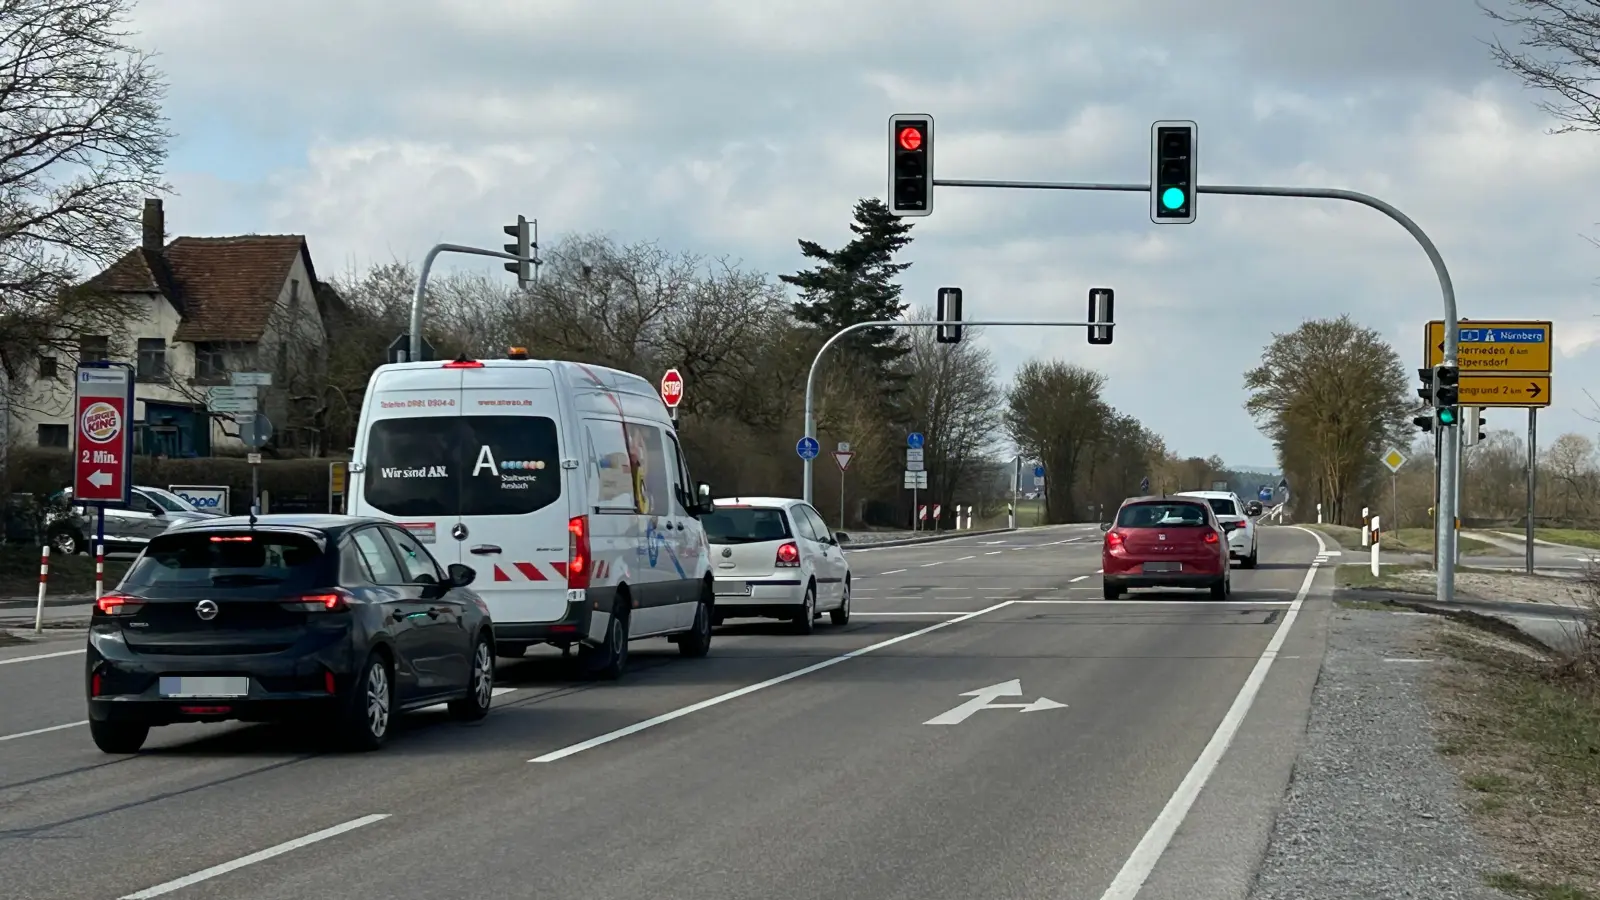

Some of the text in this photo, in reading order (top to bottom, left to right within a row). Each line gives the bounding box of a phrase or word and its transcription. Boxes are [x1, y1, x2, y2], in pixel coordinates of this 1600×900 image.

[1500, 330, 1543, 340] Nürnberg
[1457, 358, 1508, 367] Elpersdorf
[664, 380, 681, 396] STOP
[1458, 386, 1499, 395] engrund
[1503, 386, 1509, 394] 2
[87, 411, 115, 424] BURGER
[88, 418, 116, 433] KING
[82, 450, 119, 464] 2 Min.
[472, 445, 499, 476] A
[382, 465, 449, 478] Wir sind AN.
